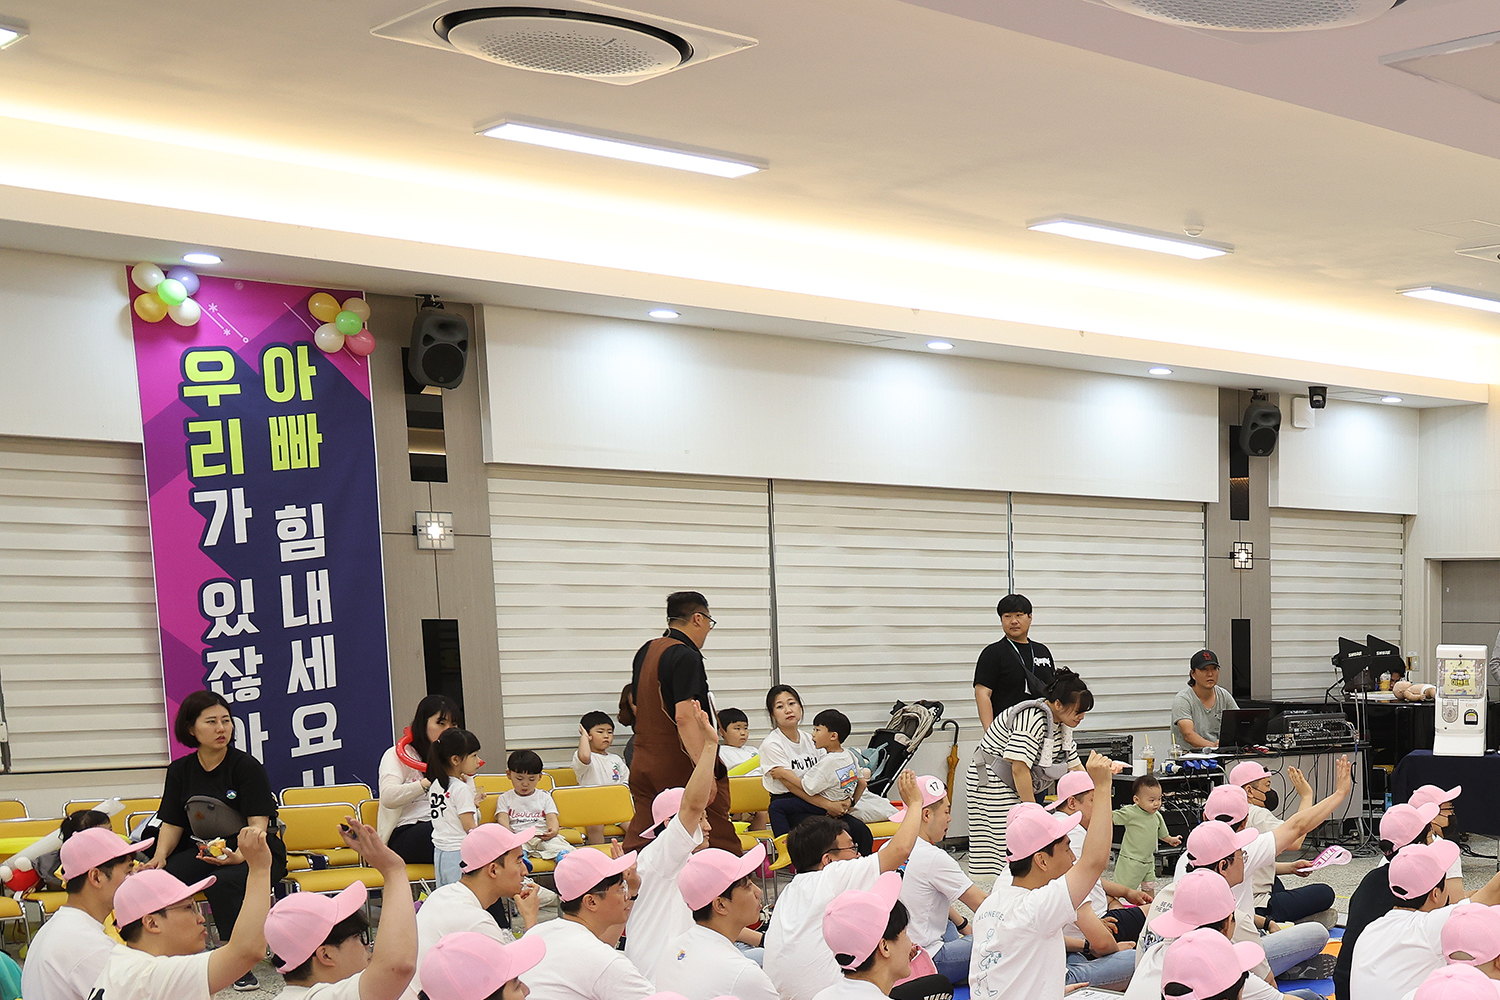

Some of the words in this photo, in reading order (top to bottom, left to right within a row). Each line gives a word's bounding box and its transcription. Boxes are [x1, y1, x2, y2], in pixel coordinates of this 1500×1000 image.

[183, 350, 253, 546] 우리가
[261, 345, 323, 471] 아빠
[929, 781, 940, 791] 17
